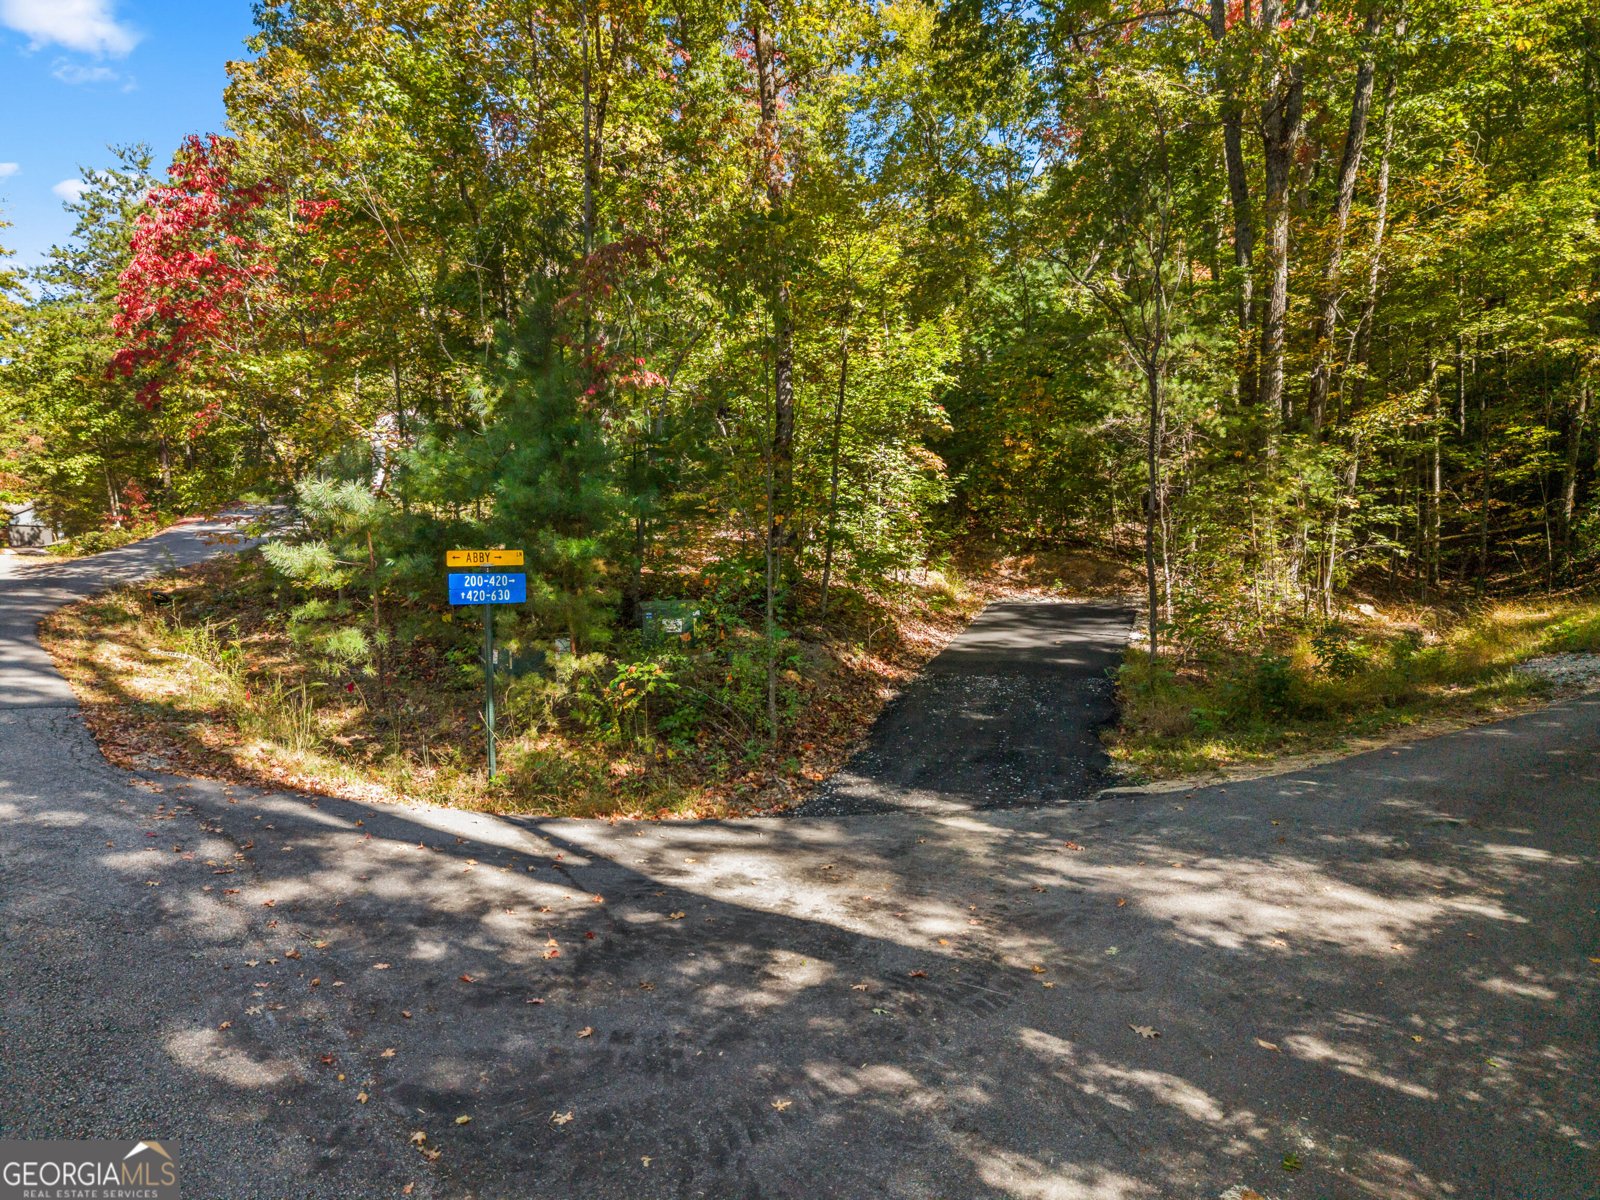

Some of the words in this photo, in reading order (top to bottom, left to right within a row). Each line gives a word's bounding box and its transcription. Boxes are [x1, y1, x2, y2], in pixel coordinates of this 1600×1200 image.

[466, 552, 490, 563] ABBY
[464, 575, 508, 587] 200-420
[466, 589, 510, 602] 420-630
